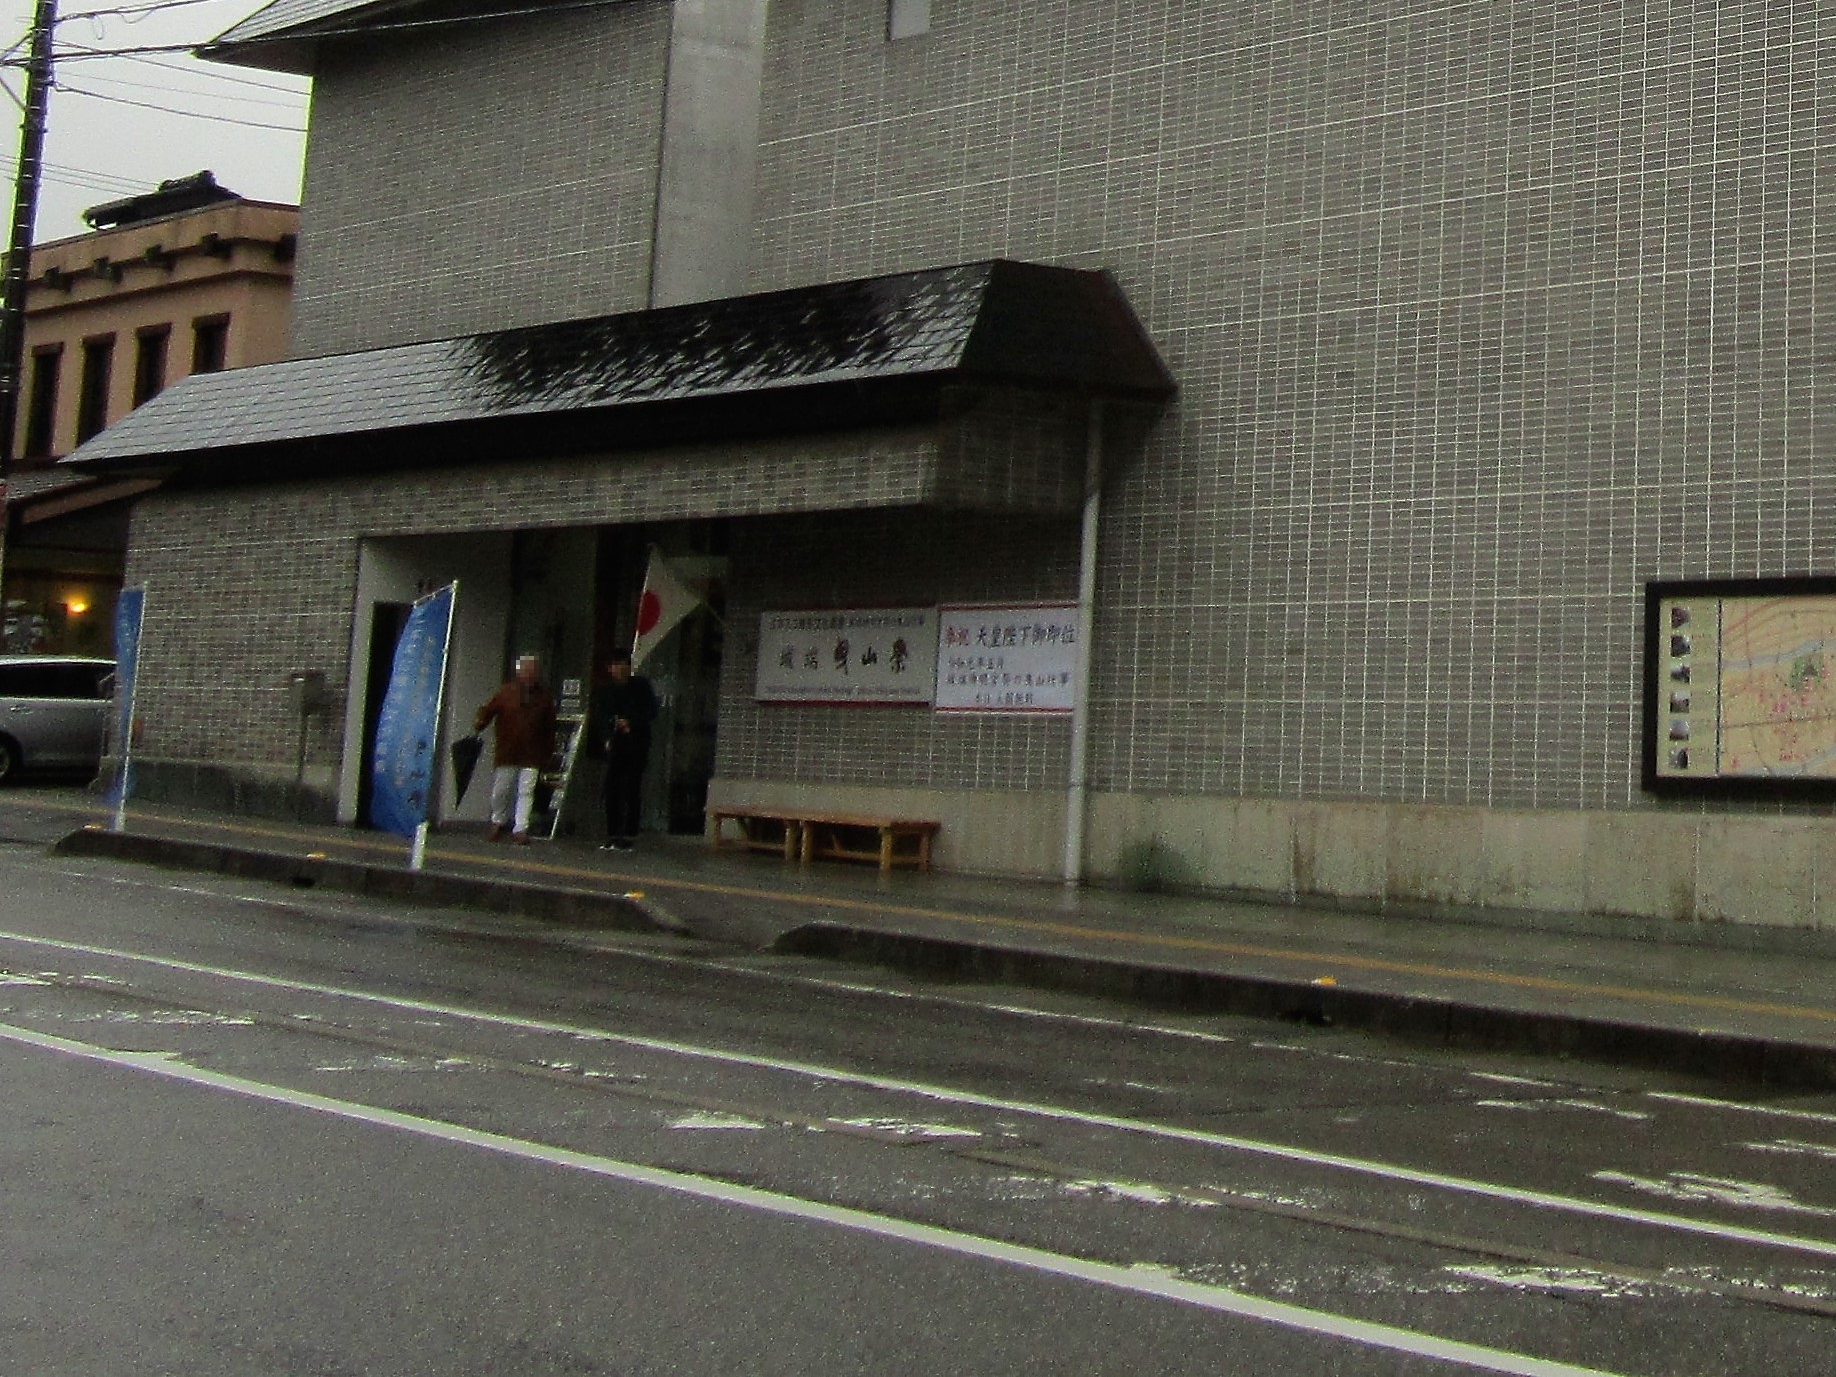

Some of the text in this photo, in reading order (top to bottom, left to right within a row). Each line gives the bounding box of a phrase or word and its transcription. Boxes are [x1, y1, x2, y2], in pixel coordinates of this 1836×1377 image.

[976, 623, 1076, 649] 天皇陛下御即位
[778, 636, 909, 676] 城端曳山祭
